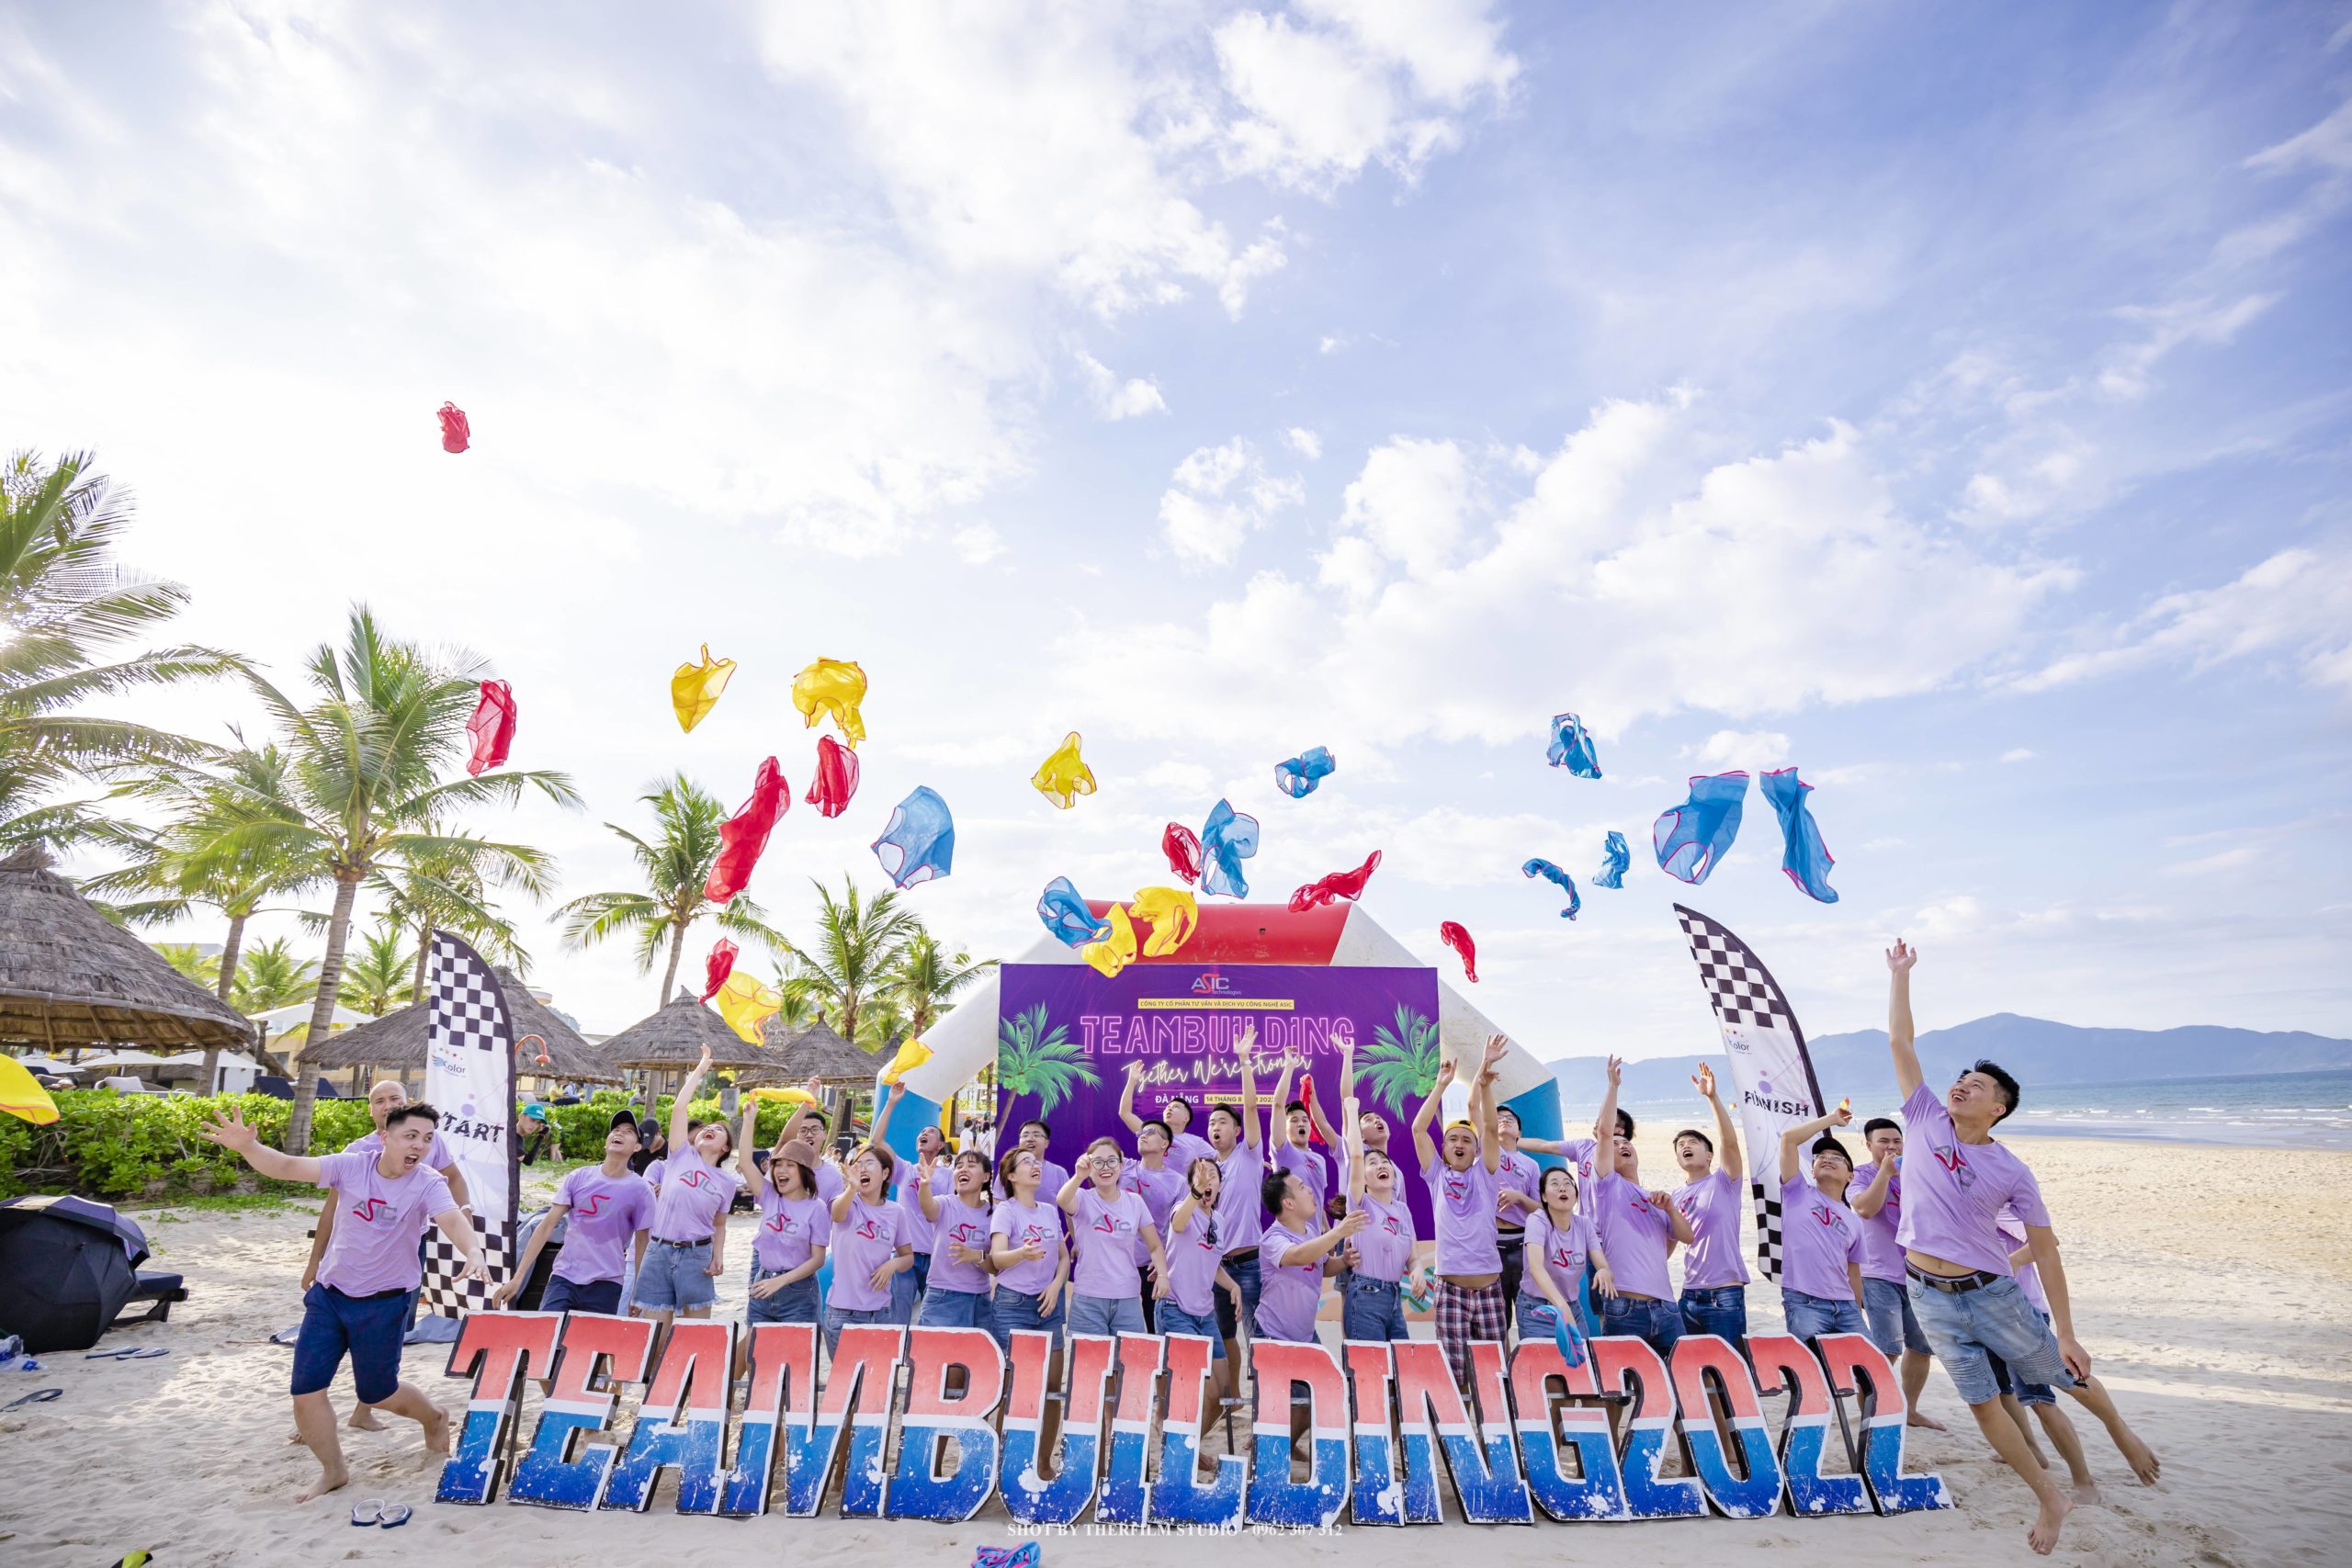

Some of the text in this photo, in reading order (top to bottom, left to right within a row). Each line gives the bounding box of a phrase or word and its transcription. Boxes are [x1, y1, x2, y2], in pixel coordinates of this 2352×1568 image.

[1190, 973, 1230, 994] ASIC
[1245, 999, 1262, 1008] CÔNG
[1121, 1060, 1189, 1093] Tgether
[1155, 1093, 1169, 1103] ĐÀ
[1215, 1094, 1236, 1102] THÁNG
[1745, 1090, 1809, 1117] FINISH
[435, 1111, 504, 1144] TART
[679, 1169, 717, 1196] ASIC
[352, 1197, 397, 1222] ASIC
[765, 1213, 798, 1235] ASC
[855, 1220, 890, 1241] ASIC
[948, 1223, 985, 1243] ASIC
[1091, 1213, 1132, 1233] ASIC
[1551, 1247, 1585, 1268] ASIC
